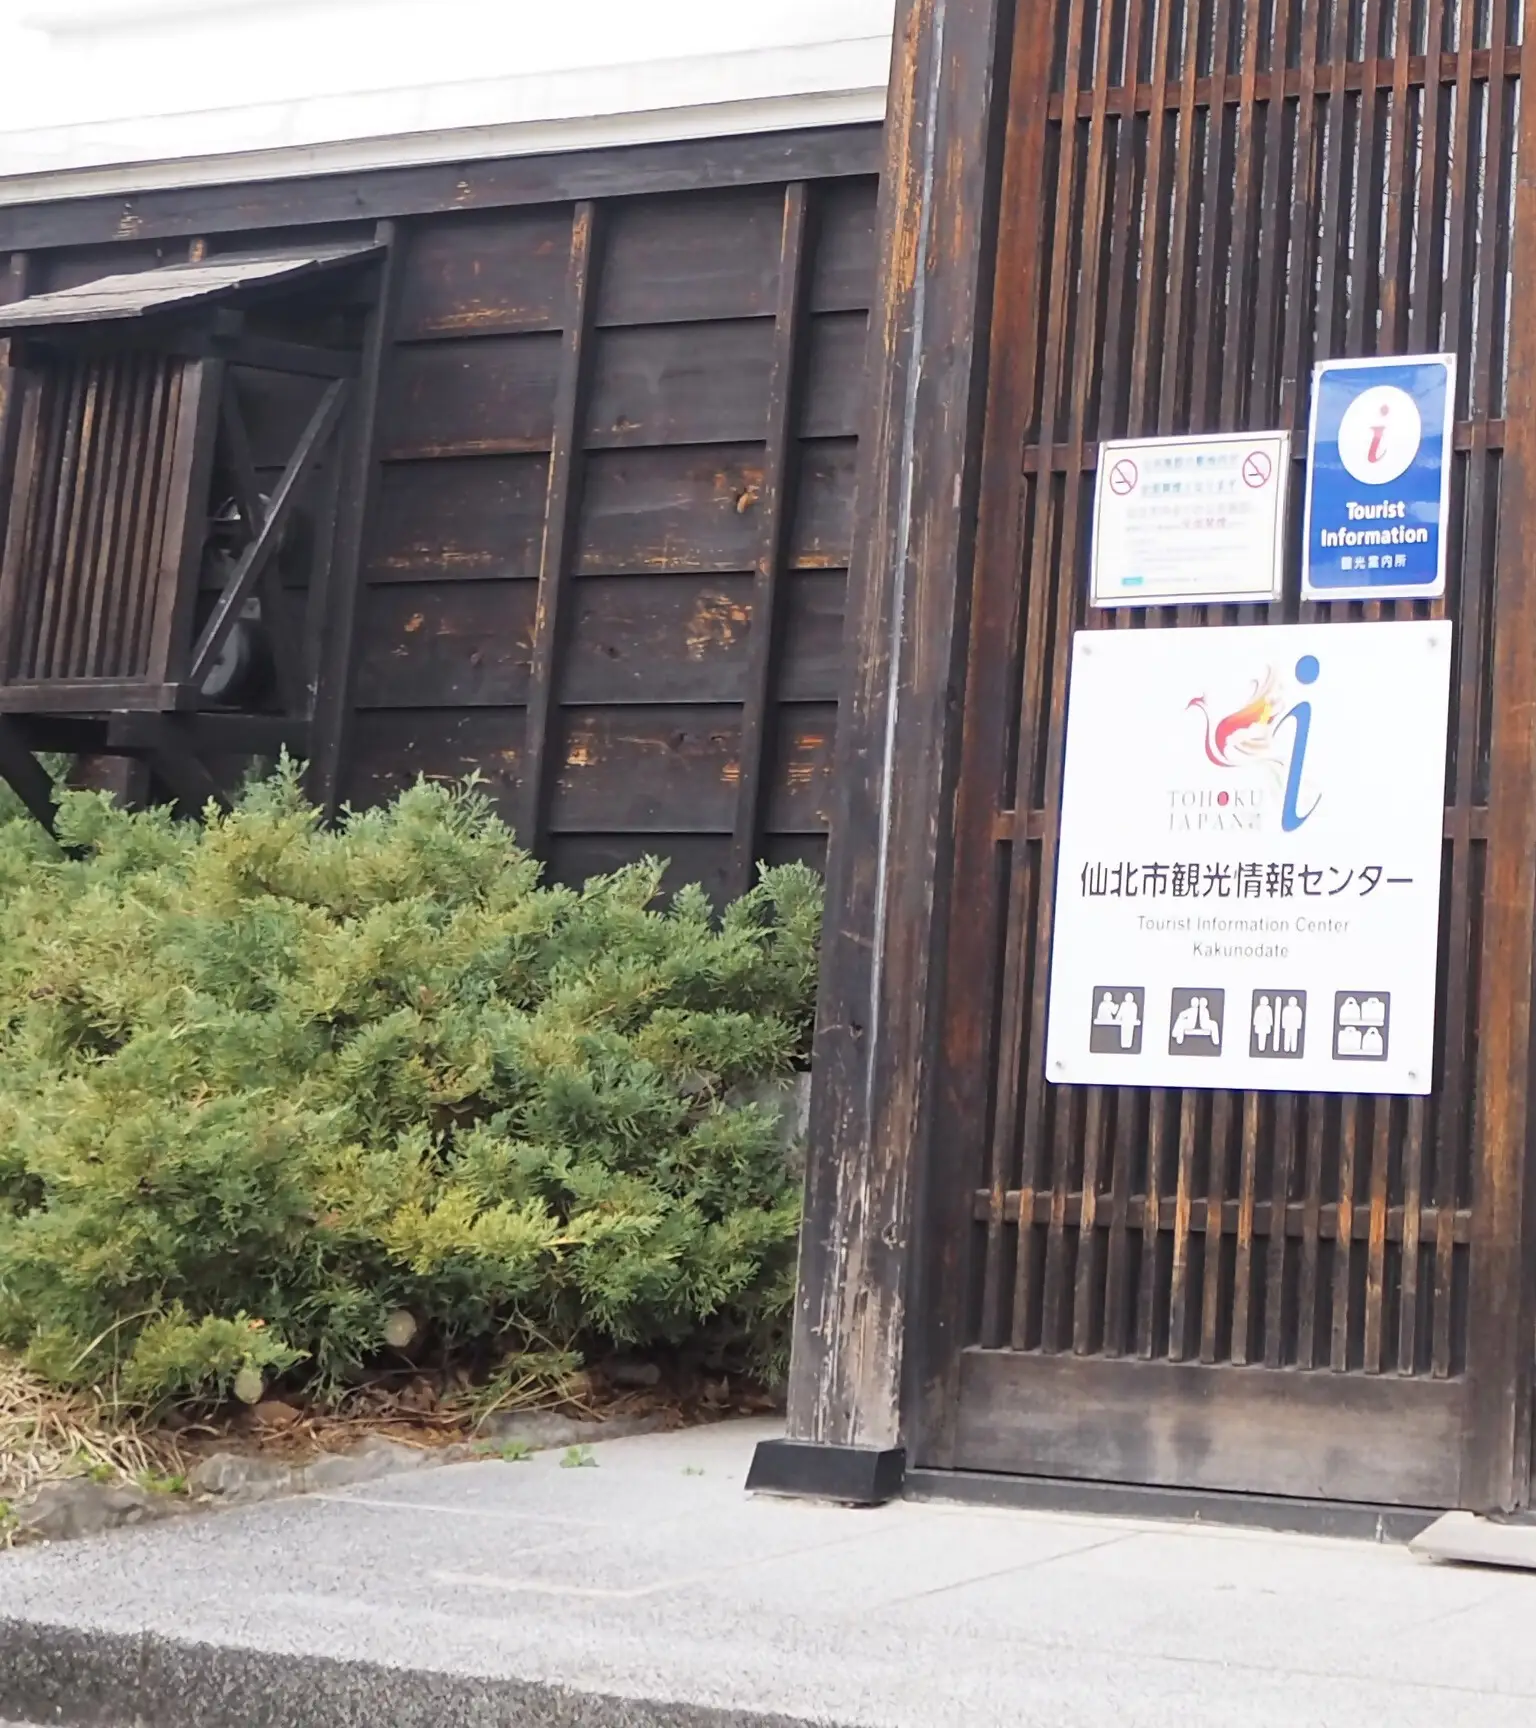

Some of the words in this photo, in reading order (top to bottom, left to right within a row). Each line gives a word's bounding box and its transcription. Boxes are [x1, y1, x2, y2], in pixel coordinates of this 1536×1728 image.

[1344, 500, 1406, 522] Tourist
[1320, 525, 1429, 549] Information
[1340, 553, 1408, 572] 観光案内所
[1166, 787, 1263, 809] TOHOKU
[1167, 811, 1246, 833] JAPAN
[1081, 860, 1414, 900] 仙北市観光情報センター
[1138, 915, 1191, 932] Tourist
[1197, 915, 1291, 933] Information
[1295, 917, 1351, 934] Center
[1192, 941, 1290, 959] Kakunodate
